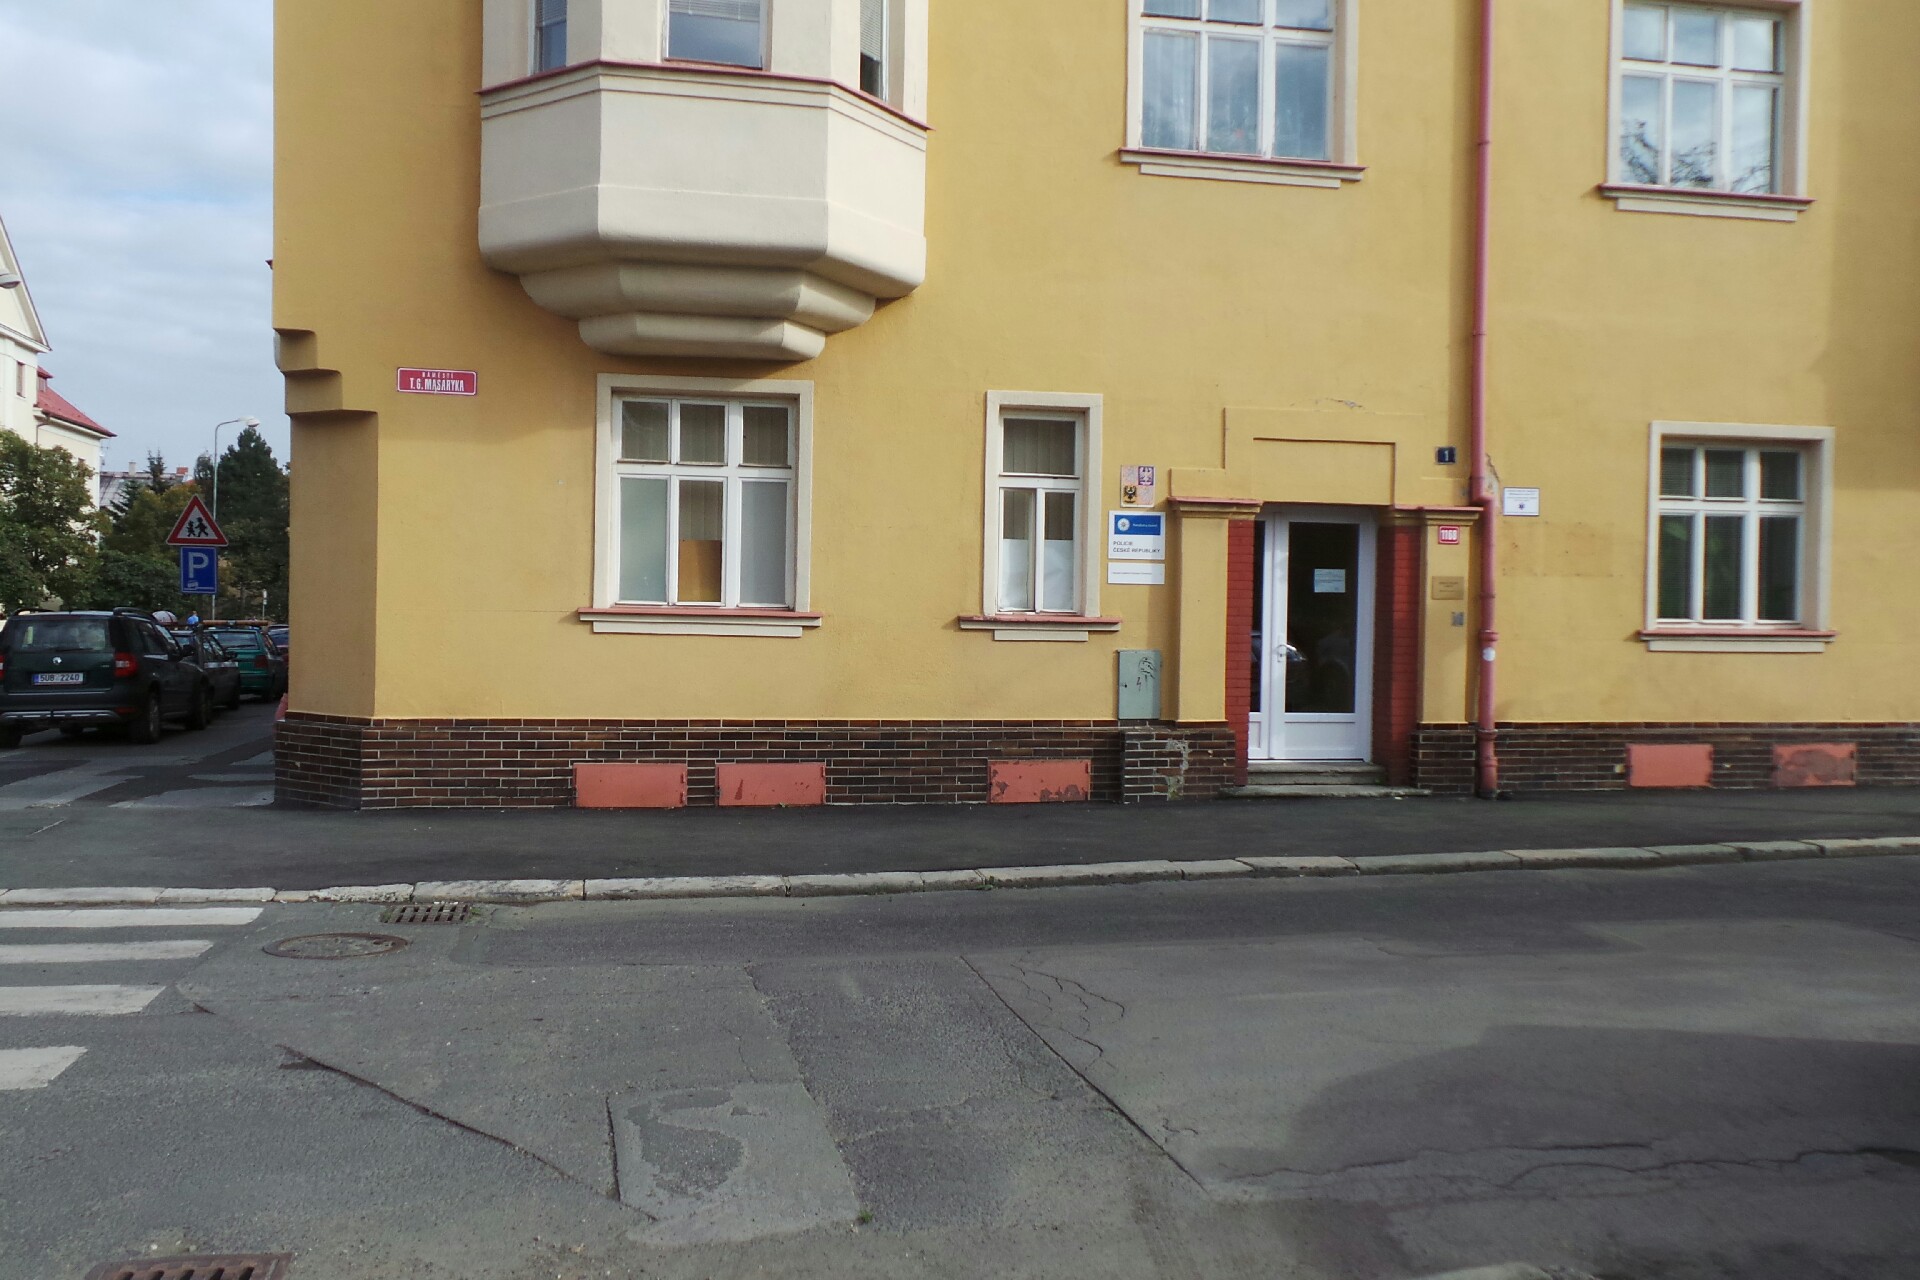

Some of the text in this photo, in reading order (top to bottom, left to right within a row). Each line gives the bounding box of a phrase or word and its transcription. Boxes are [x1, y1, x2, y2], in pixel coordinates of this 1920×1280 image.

[424, 379, 465, 392] MASARYKA
[1444, 450, 1449, 461] 1
[188, 552, 208, 579] P
